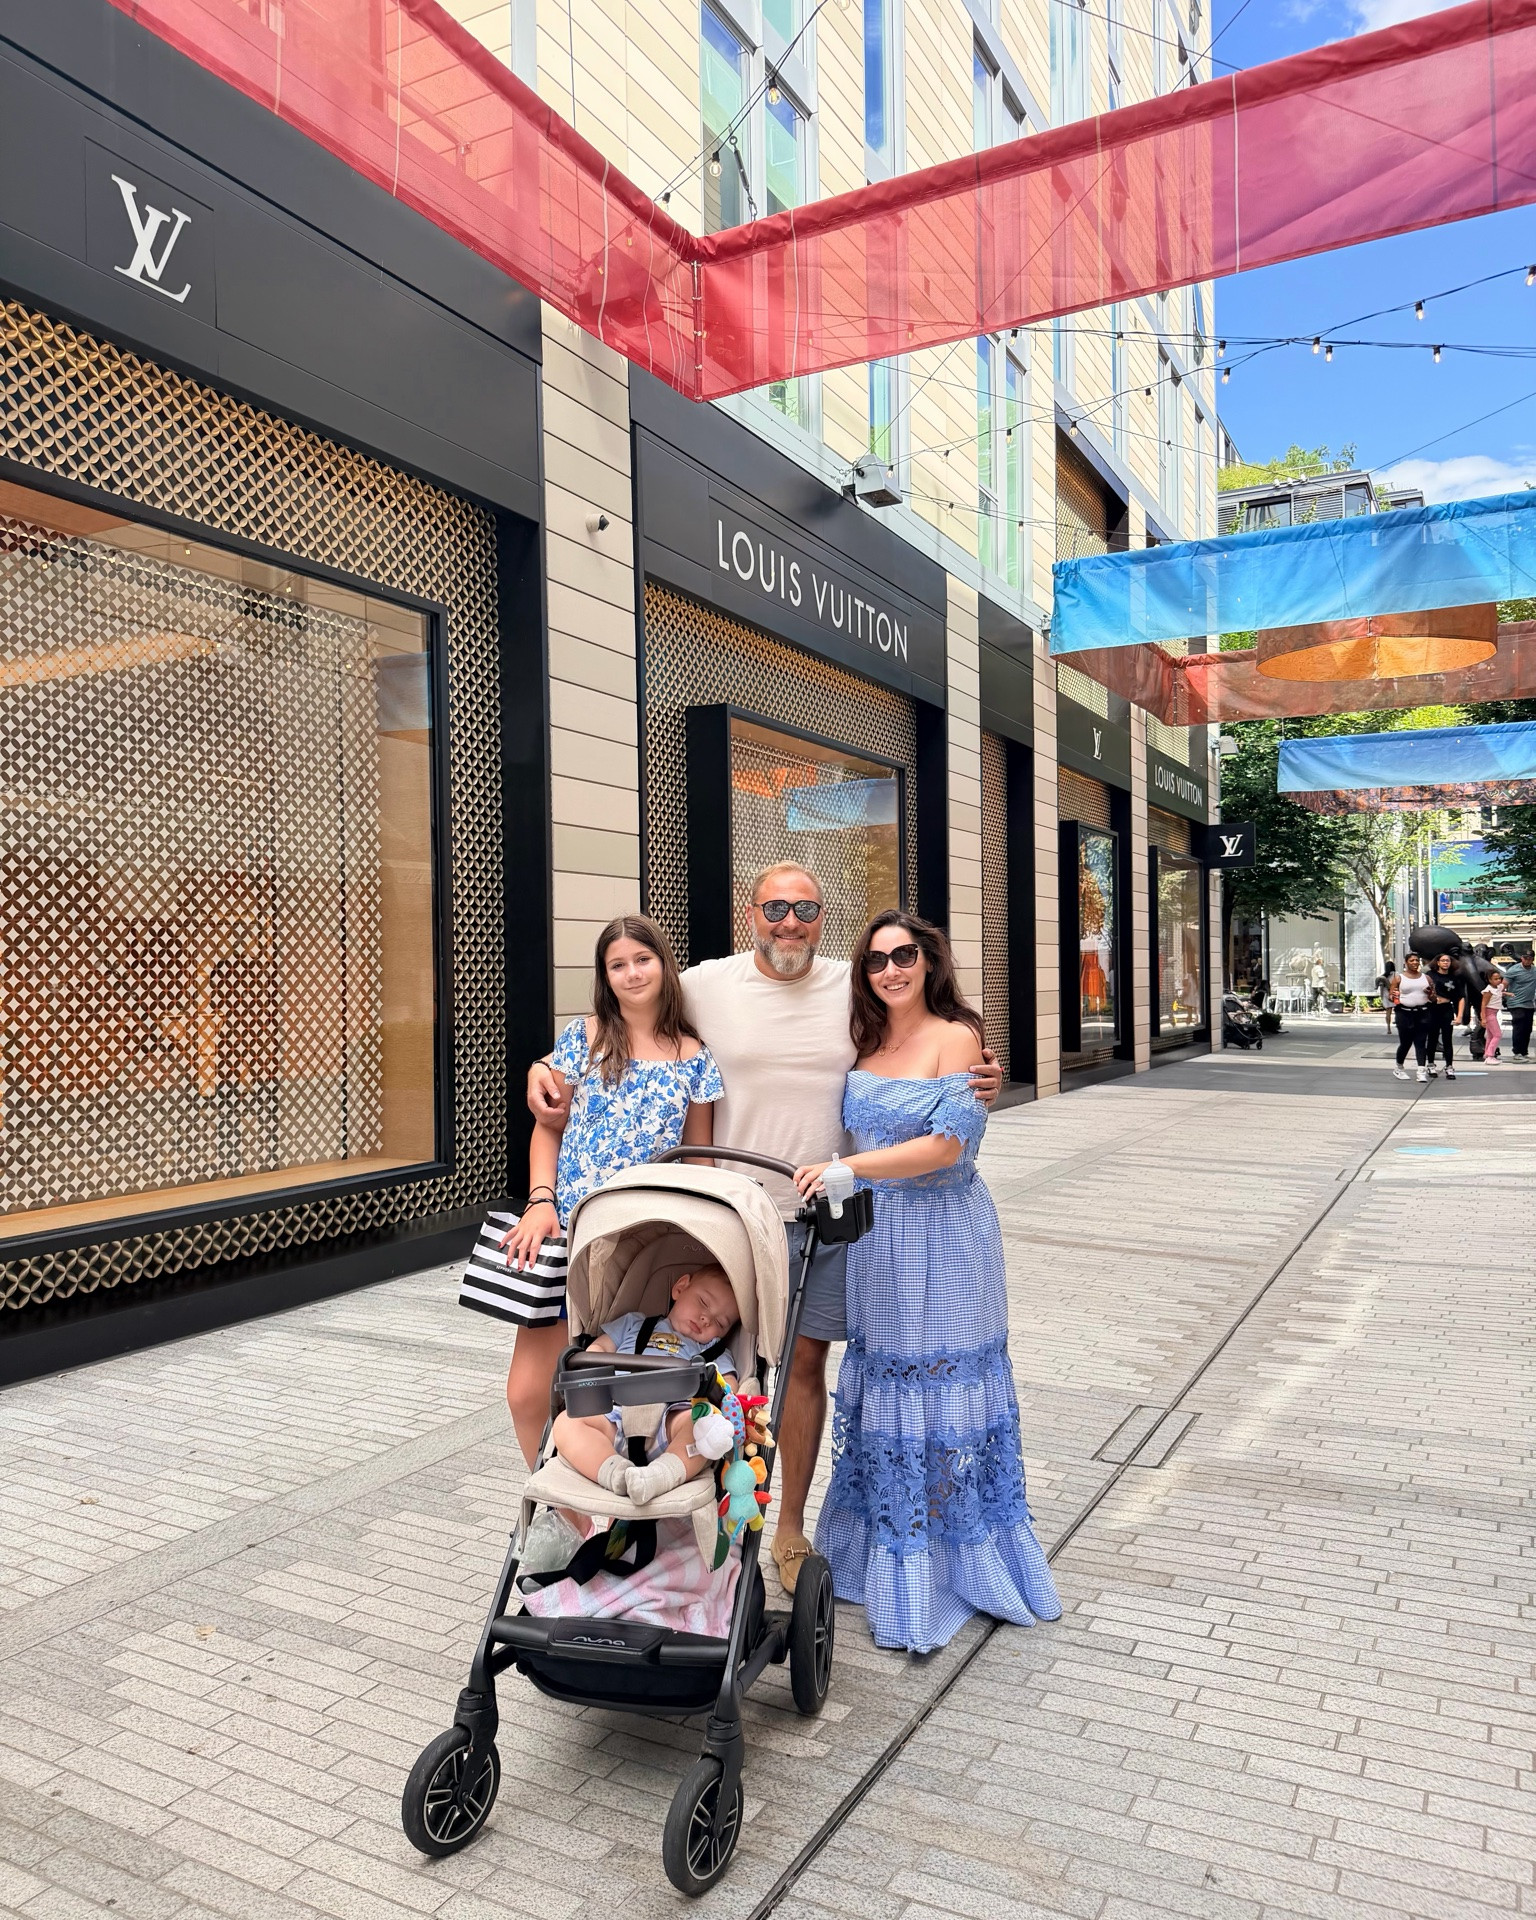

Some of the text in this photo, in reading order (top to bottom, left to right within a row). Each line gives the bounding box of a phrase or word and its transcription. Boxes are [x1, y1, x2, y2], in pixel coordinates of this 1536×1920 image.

[111, 173, 192, 304] LV
[717, 519, 908, 664] LOUIS VUITTON
[1154, 764, 1202, 808] LOUIS VUITTON
[1219, 834, 1243, 858] LV
[572, 1636, 626, 1646] nuna
